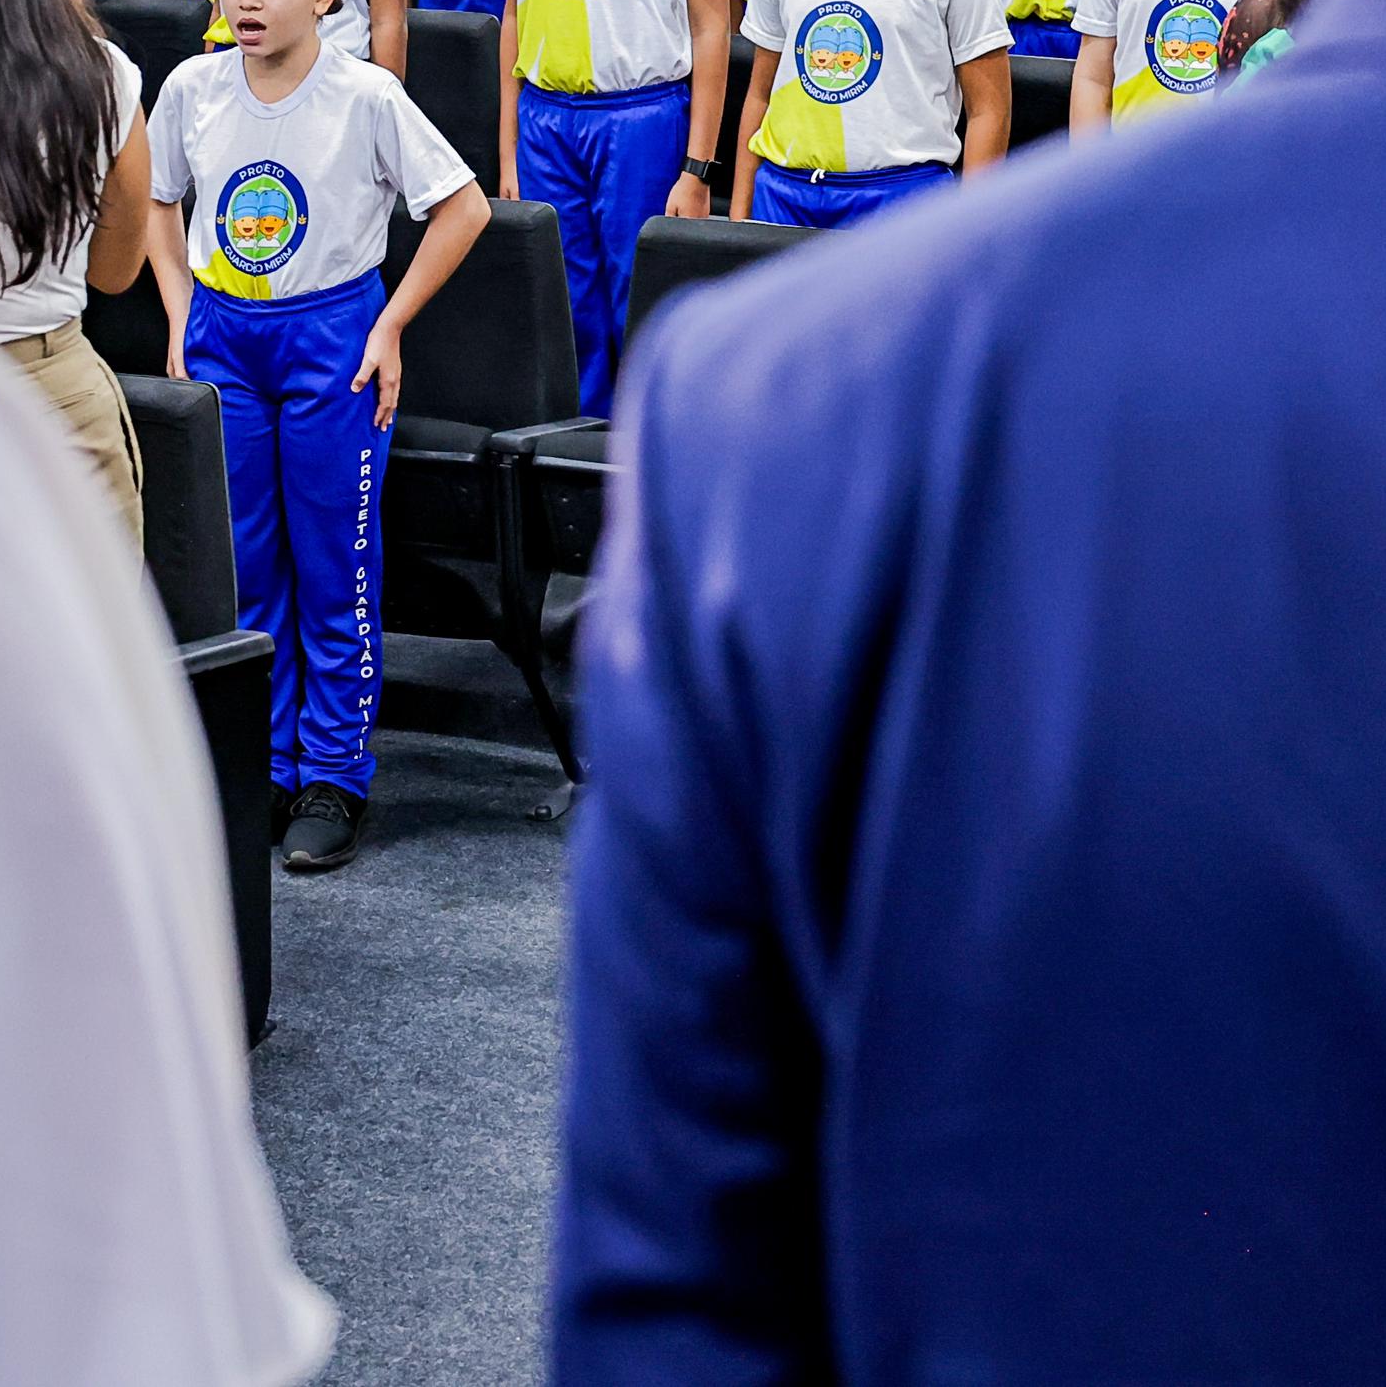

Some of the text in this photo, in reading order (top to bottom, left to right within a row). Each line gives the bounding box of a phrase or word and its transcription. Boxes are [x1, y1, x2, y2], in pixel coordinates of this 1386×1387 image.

[817, 2, 862, 19] PROJETO
[800, 73, 868, 101] GUARDIÃO MIRIM
[1151, 63, 1217, 92] GUARDIÃO MIR
[238, 164, 284, 180] PROETO
[264, 246, 293, 272] MIRIM
[353, 449, 372, 551] PROJETO
[354, 566, 375, 679] GUARDIÃO
